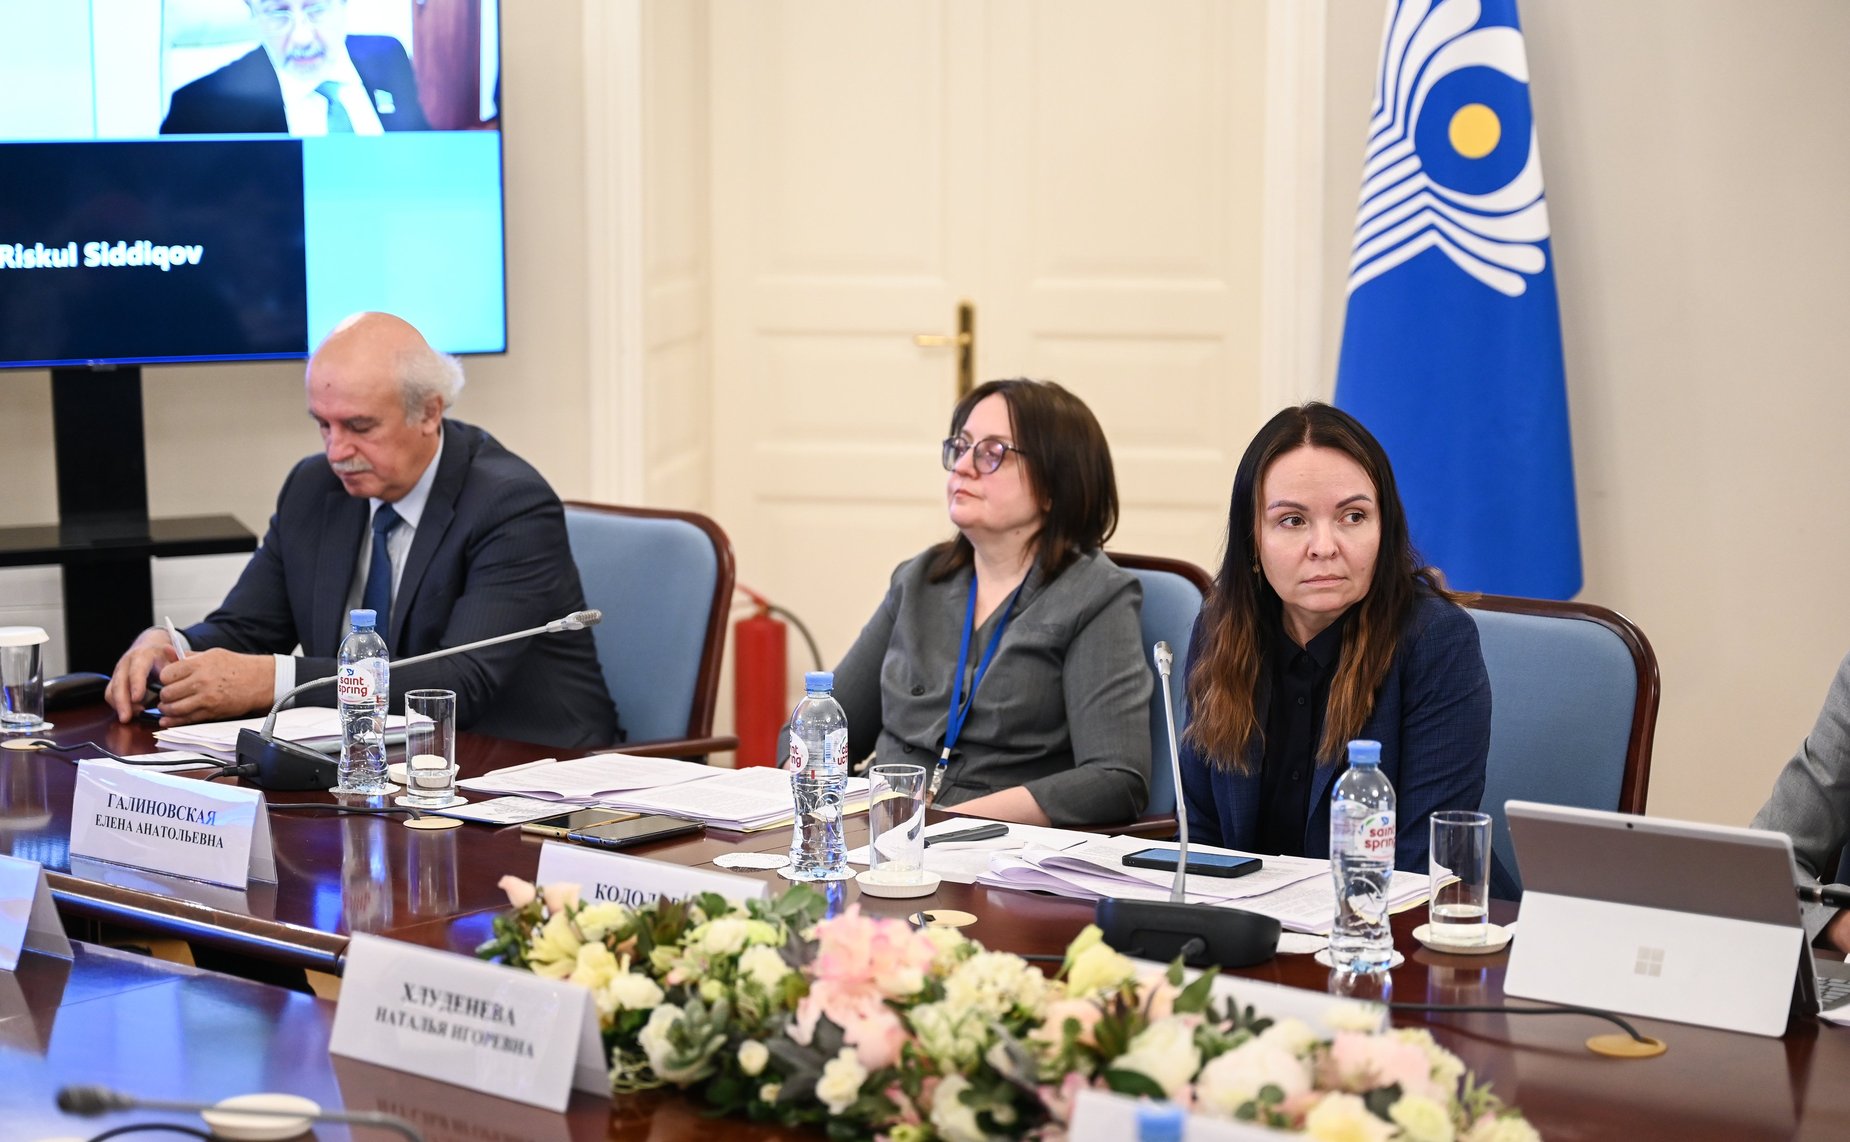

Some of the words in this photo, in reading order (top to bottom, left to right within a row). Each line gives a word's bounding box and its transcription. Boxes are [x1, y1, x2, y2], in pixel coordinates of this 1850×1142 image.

[0, 241, 78, 269] Riskul
[83, 240, 204, 272] Siddiqov
[339, 684, 368, 697] spring
[340, 676, 364, 686] saint
[107, 794, 216, 826] ГАЛИНОВСКАЯ
[95, 814, 133, 832] ЕЛЕНА
[137, 822, 224, 848] АНАТОЛЬЕВНА
[401, 982, 516, 1027] ХЛУДЕНЕВА
[375, 1006, 447, 1037] НАТАЛЬЯ
[451, 1026, 535, 1059] ИГОРЕВНА
